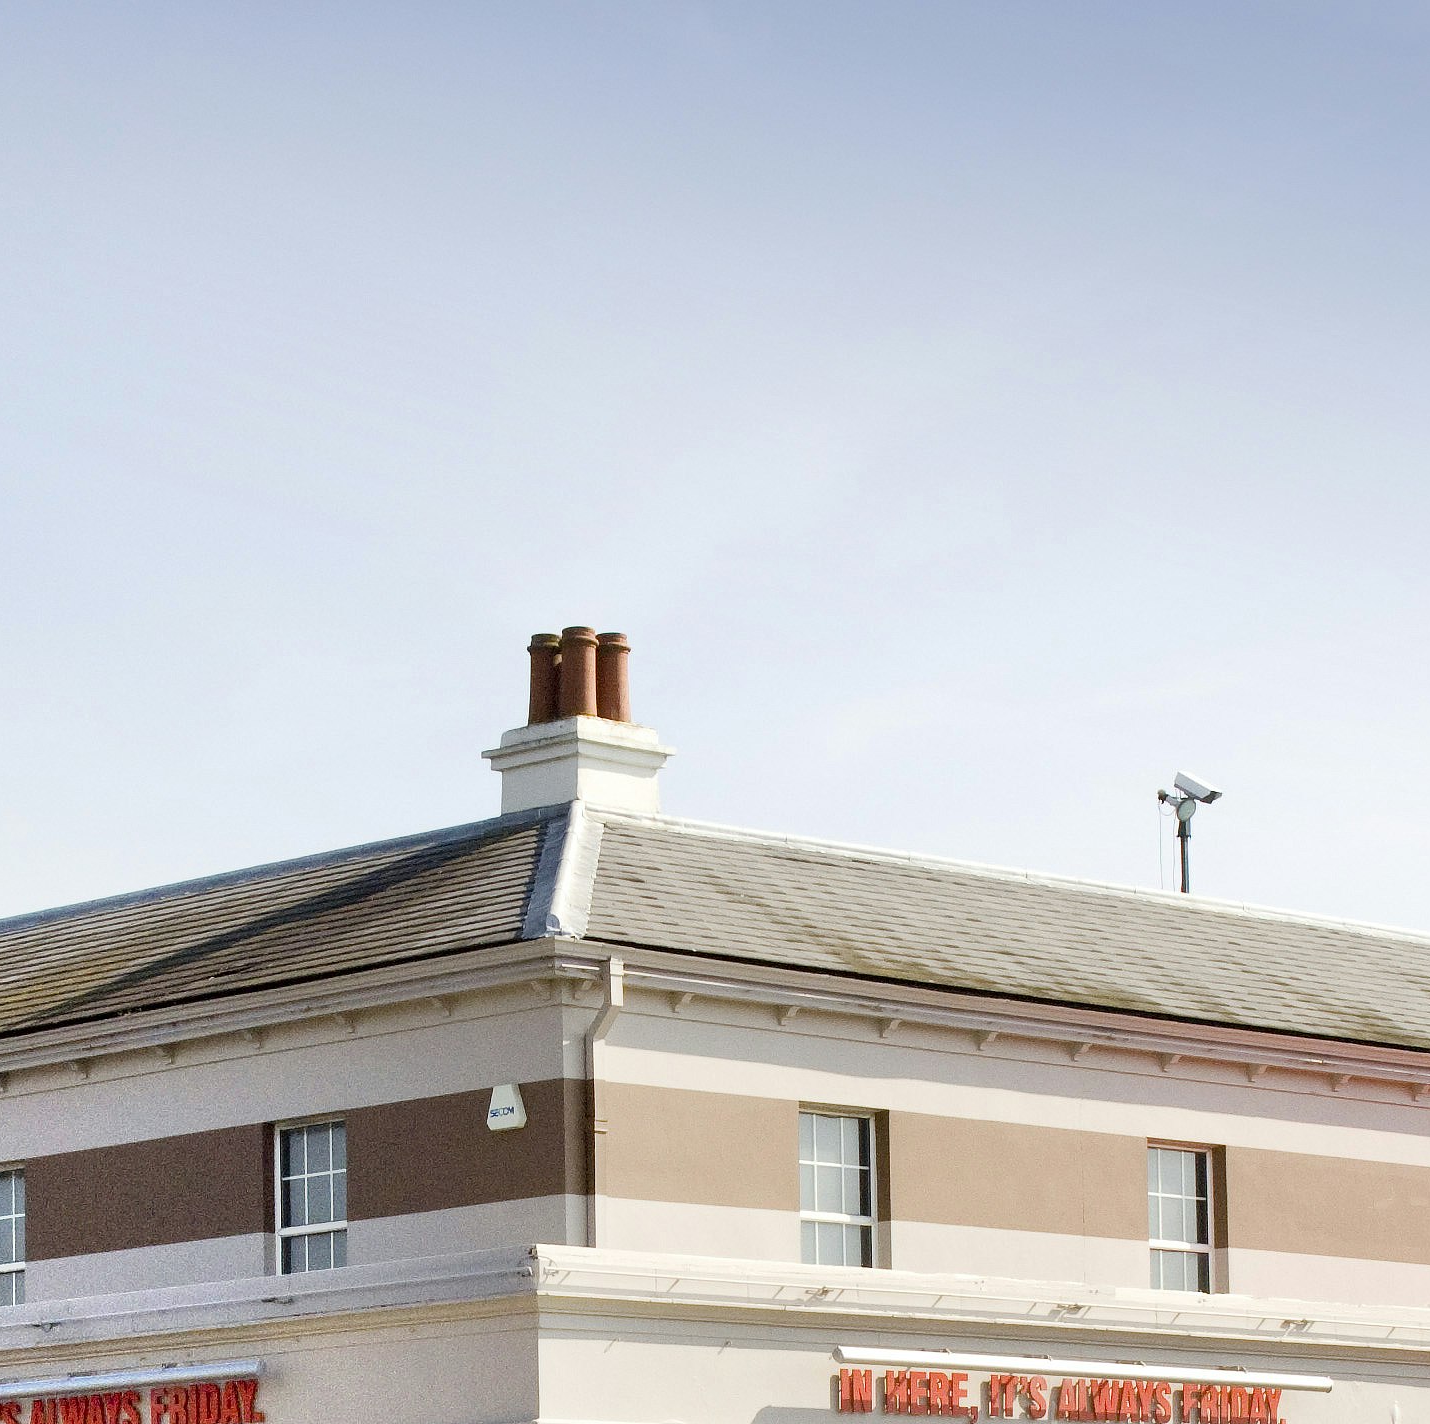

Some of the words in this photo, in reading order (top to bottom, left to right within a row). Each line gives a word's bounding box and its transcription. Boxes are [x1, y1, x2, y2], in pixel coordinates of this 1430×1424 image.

[489, 1106, 515, 1118] SECOM
[839, 1368, 873, 1413] IN
[884, 1370, 979, 1424] HERE,
[989, 1374, 1048, 1419] IT'S
[1056, 1378, 1172, 1424] ALWAYS
